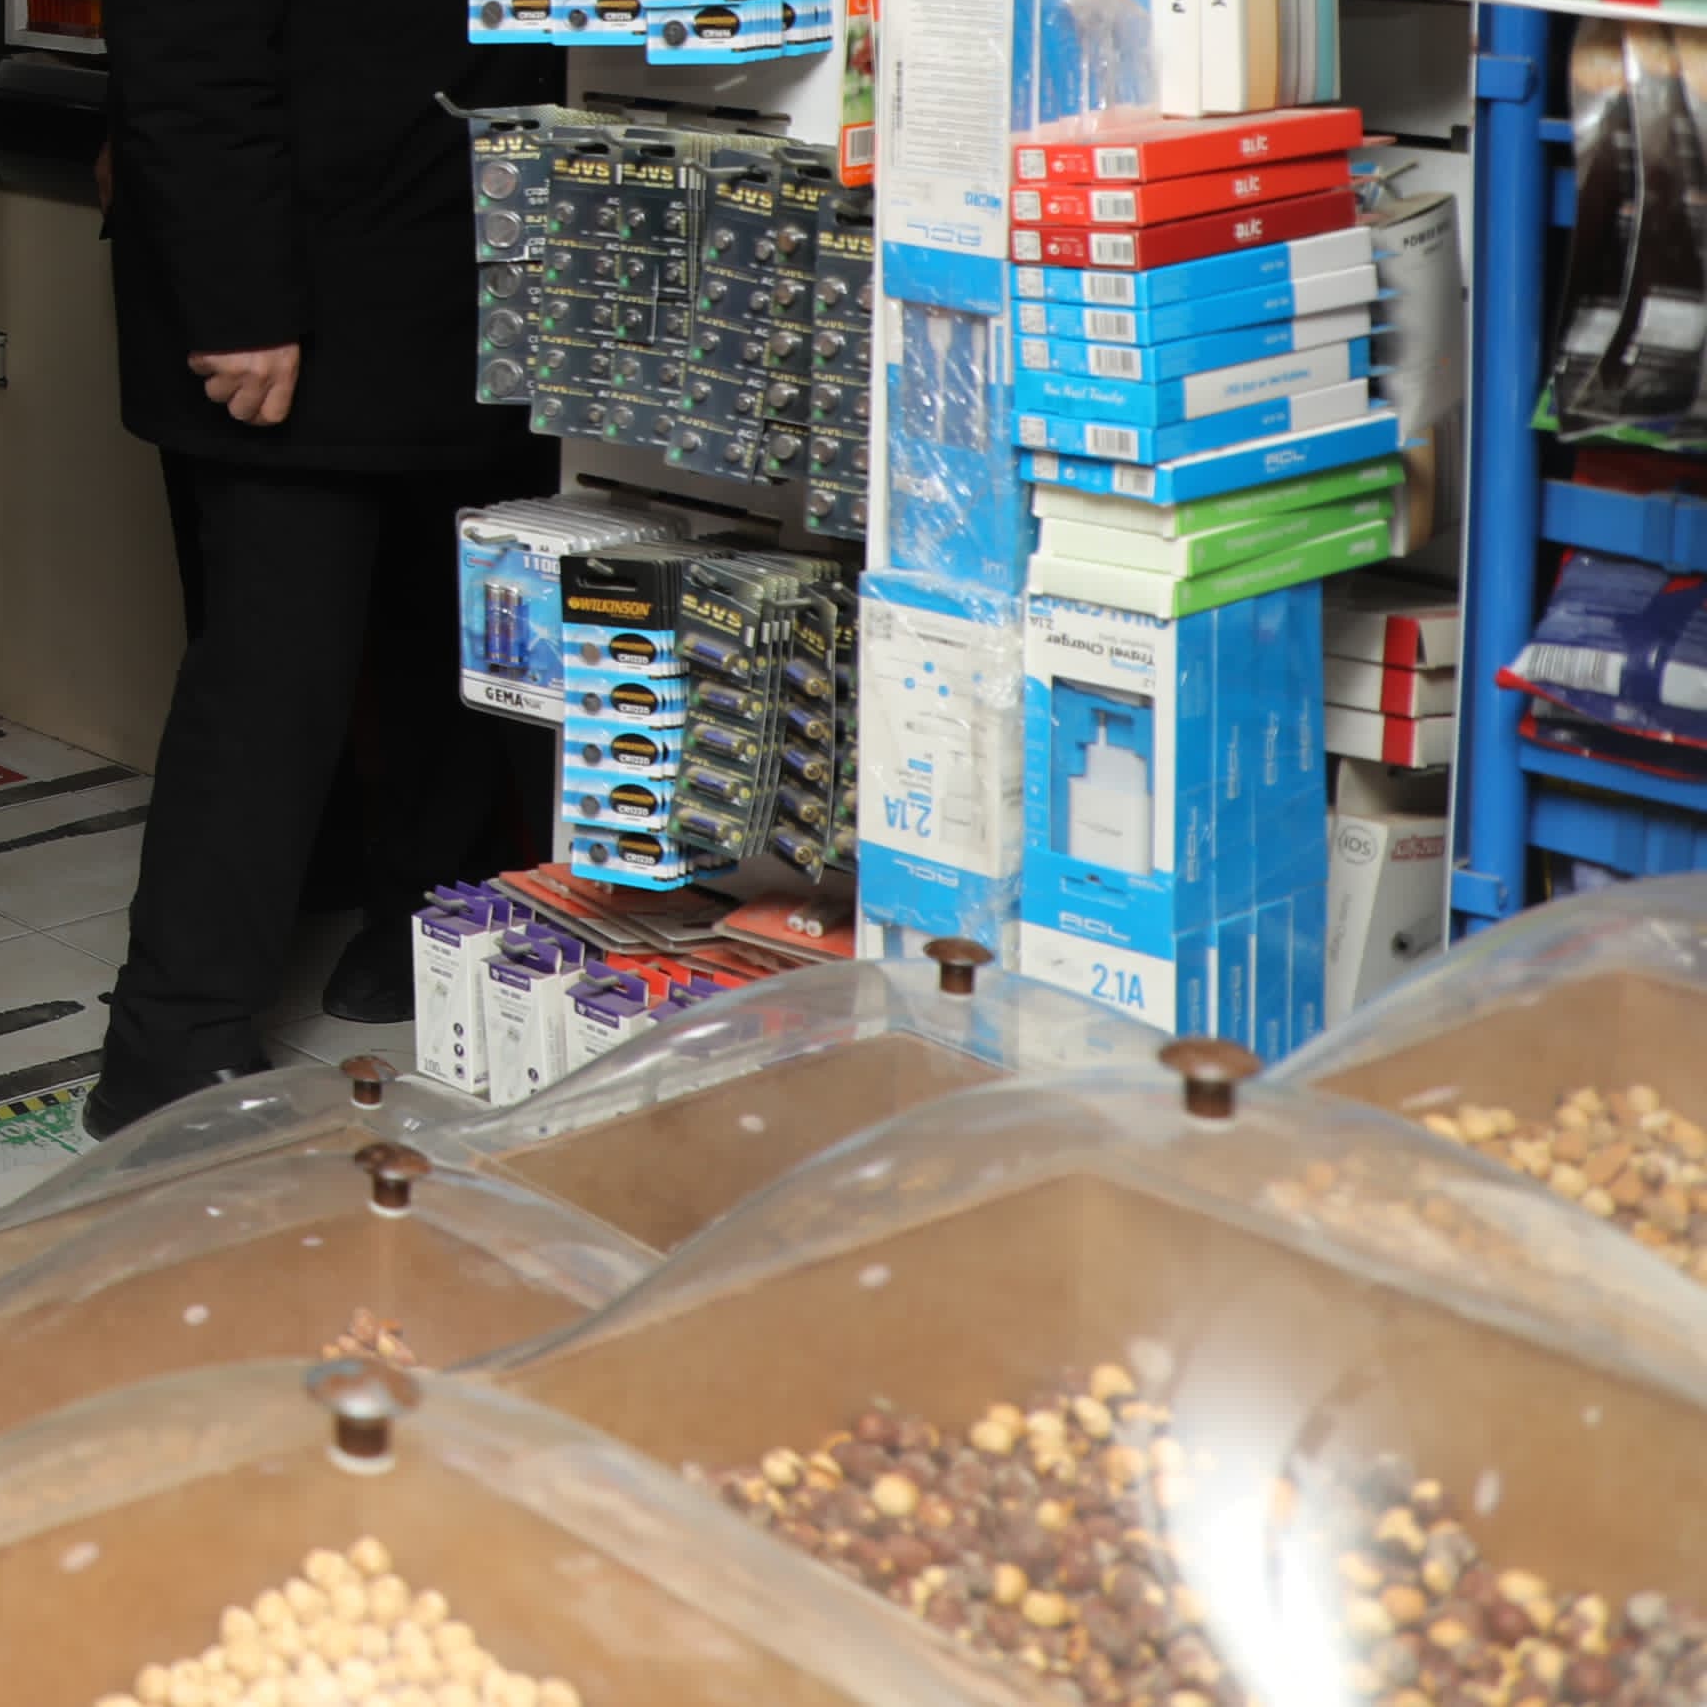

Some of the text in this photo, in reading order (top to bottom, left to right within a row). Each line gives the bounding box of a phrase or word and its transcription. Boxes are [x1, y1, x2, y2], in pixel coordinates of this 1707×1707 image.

[569, 161, 611, 178] JVS
[635, 165, 674, 182] JVS
[579, 597, 651, 618] WILKINSON
[485, 687, 524, 708] GEMA
[1090, 962, 1144, 1010] 2.1A
